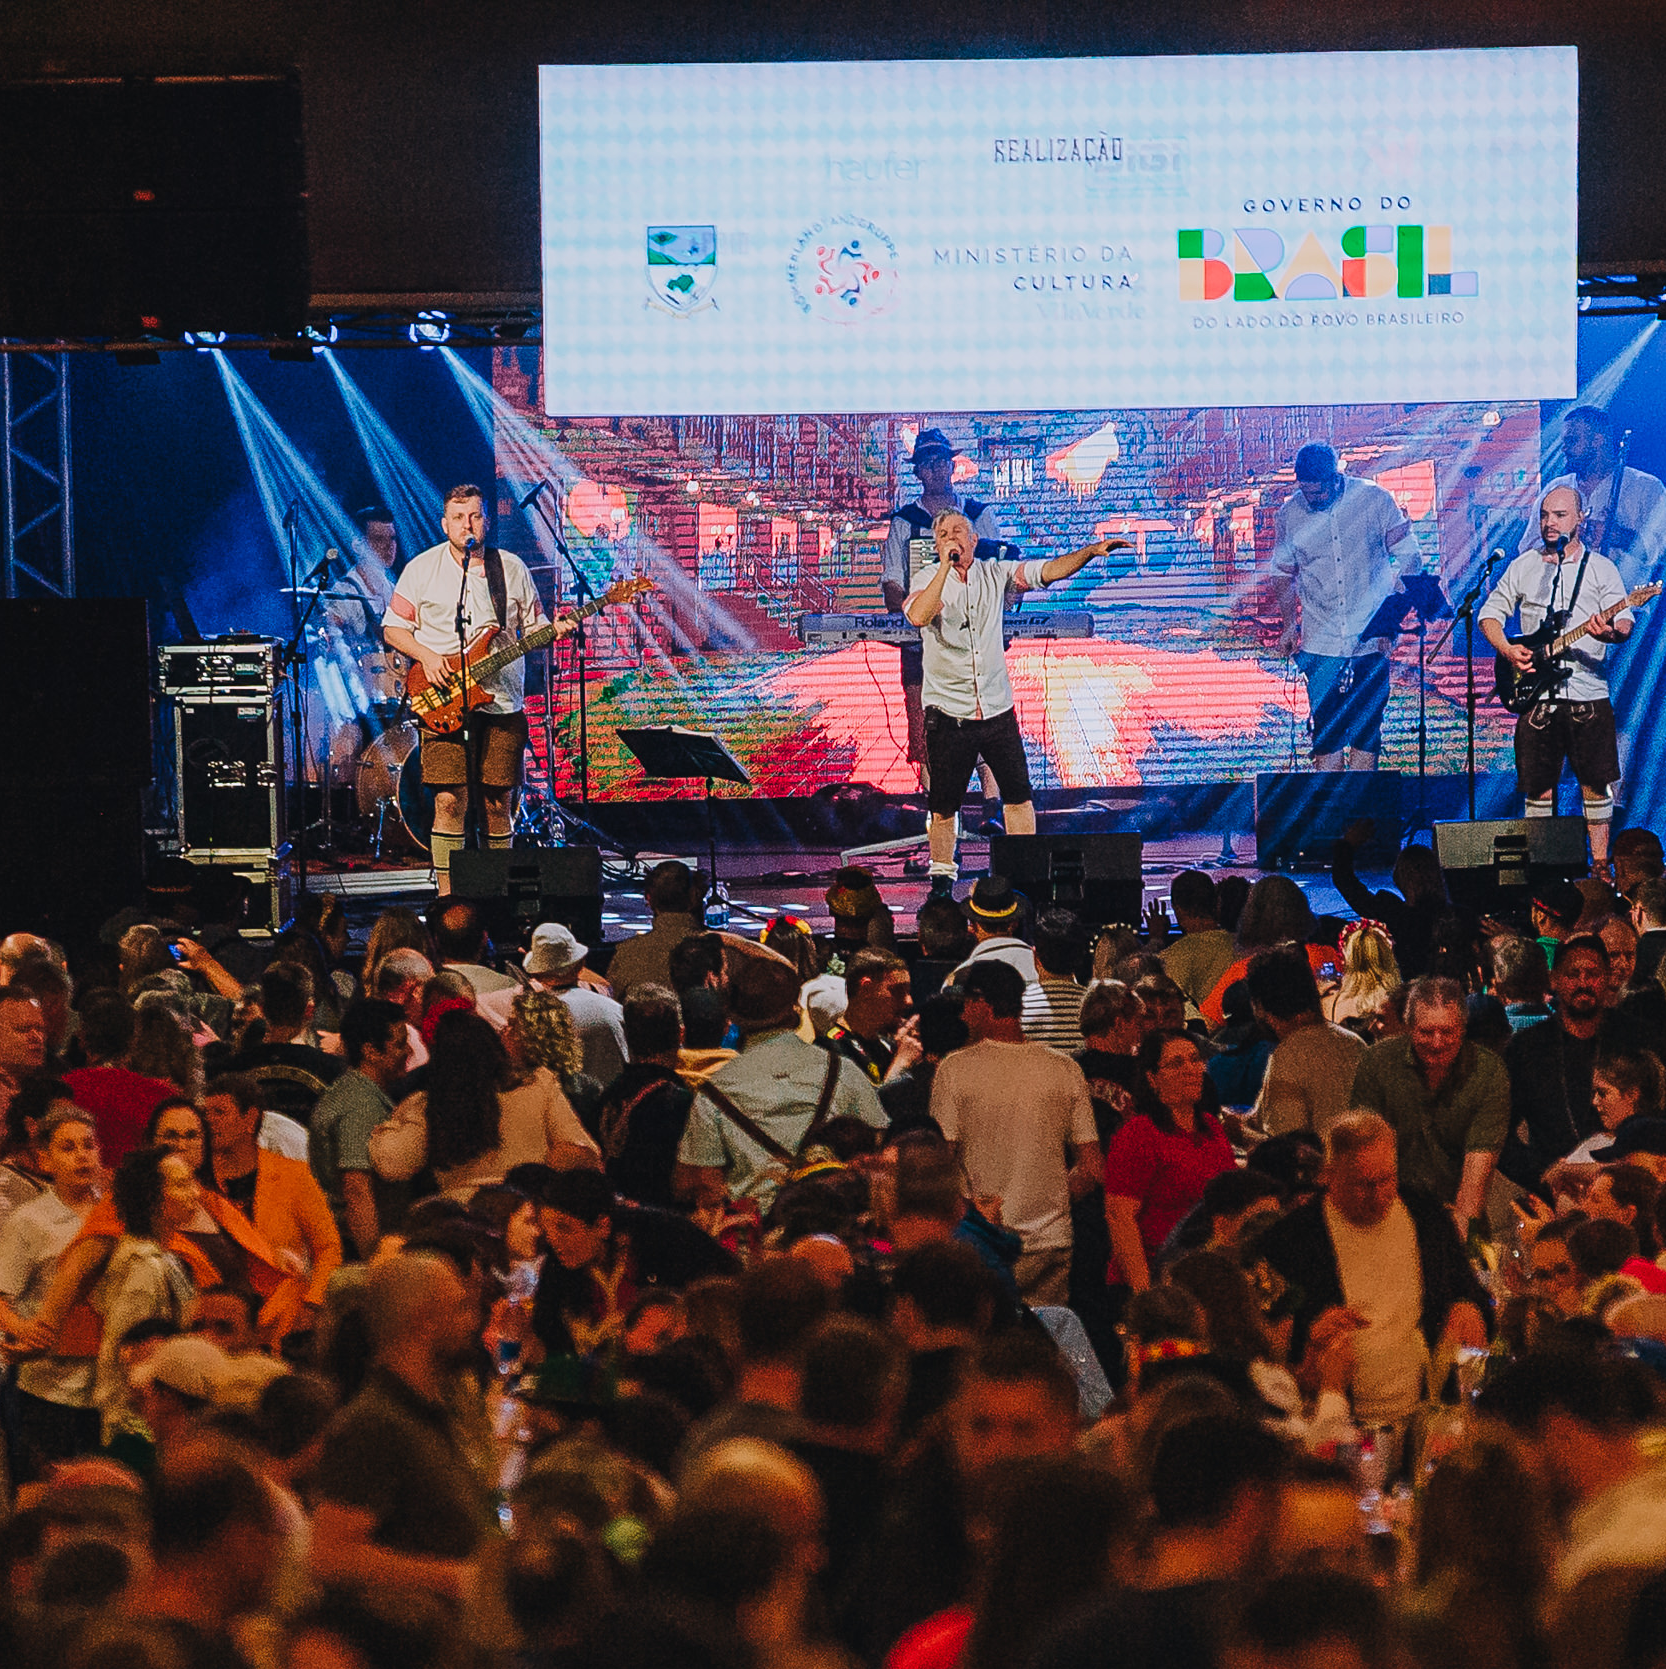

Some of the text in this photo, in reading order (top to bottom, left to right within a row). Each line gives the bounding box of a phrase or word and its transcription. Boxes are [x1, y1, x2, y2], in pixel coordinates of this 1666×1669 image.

[993, 131, 1124, 166] REALIZAÇÃO
[1243, 195, 1412, 213] GOVERNO DO
[933, 245, 1134, 265] MINISTÉRIO DA
[1177, 224, 1479, 301] BRASIL
[1013, 274, 1134, 292] CULTURA
[1192, 311, 1466, 329] DO LADO DO POVO BRASILEIRO
[853, 616, 904, 628] Roland
